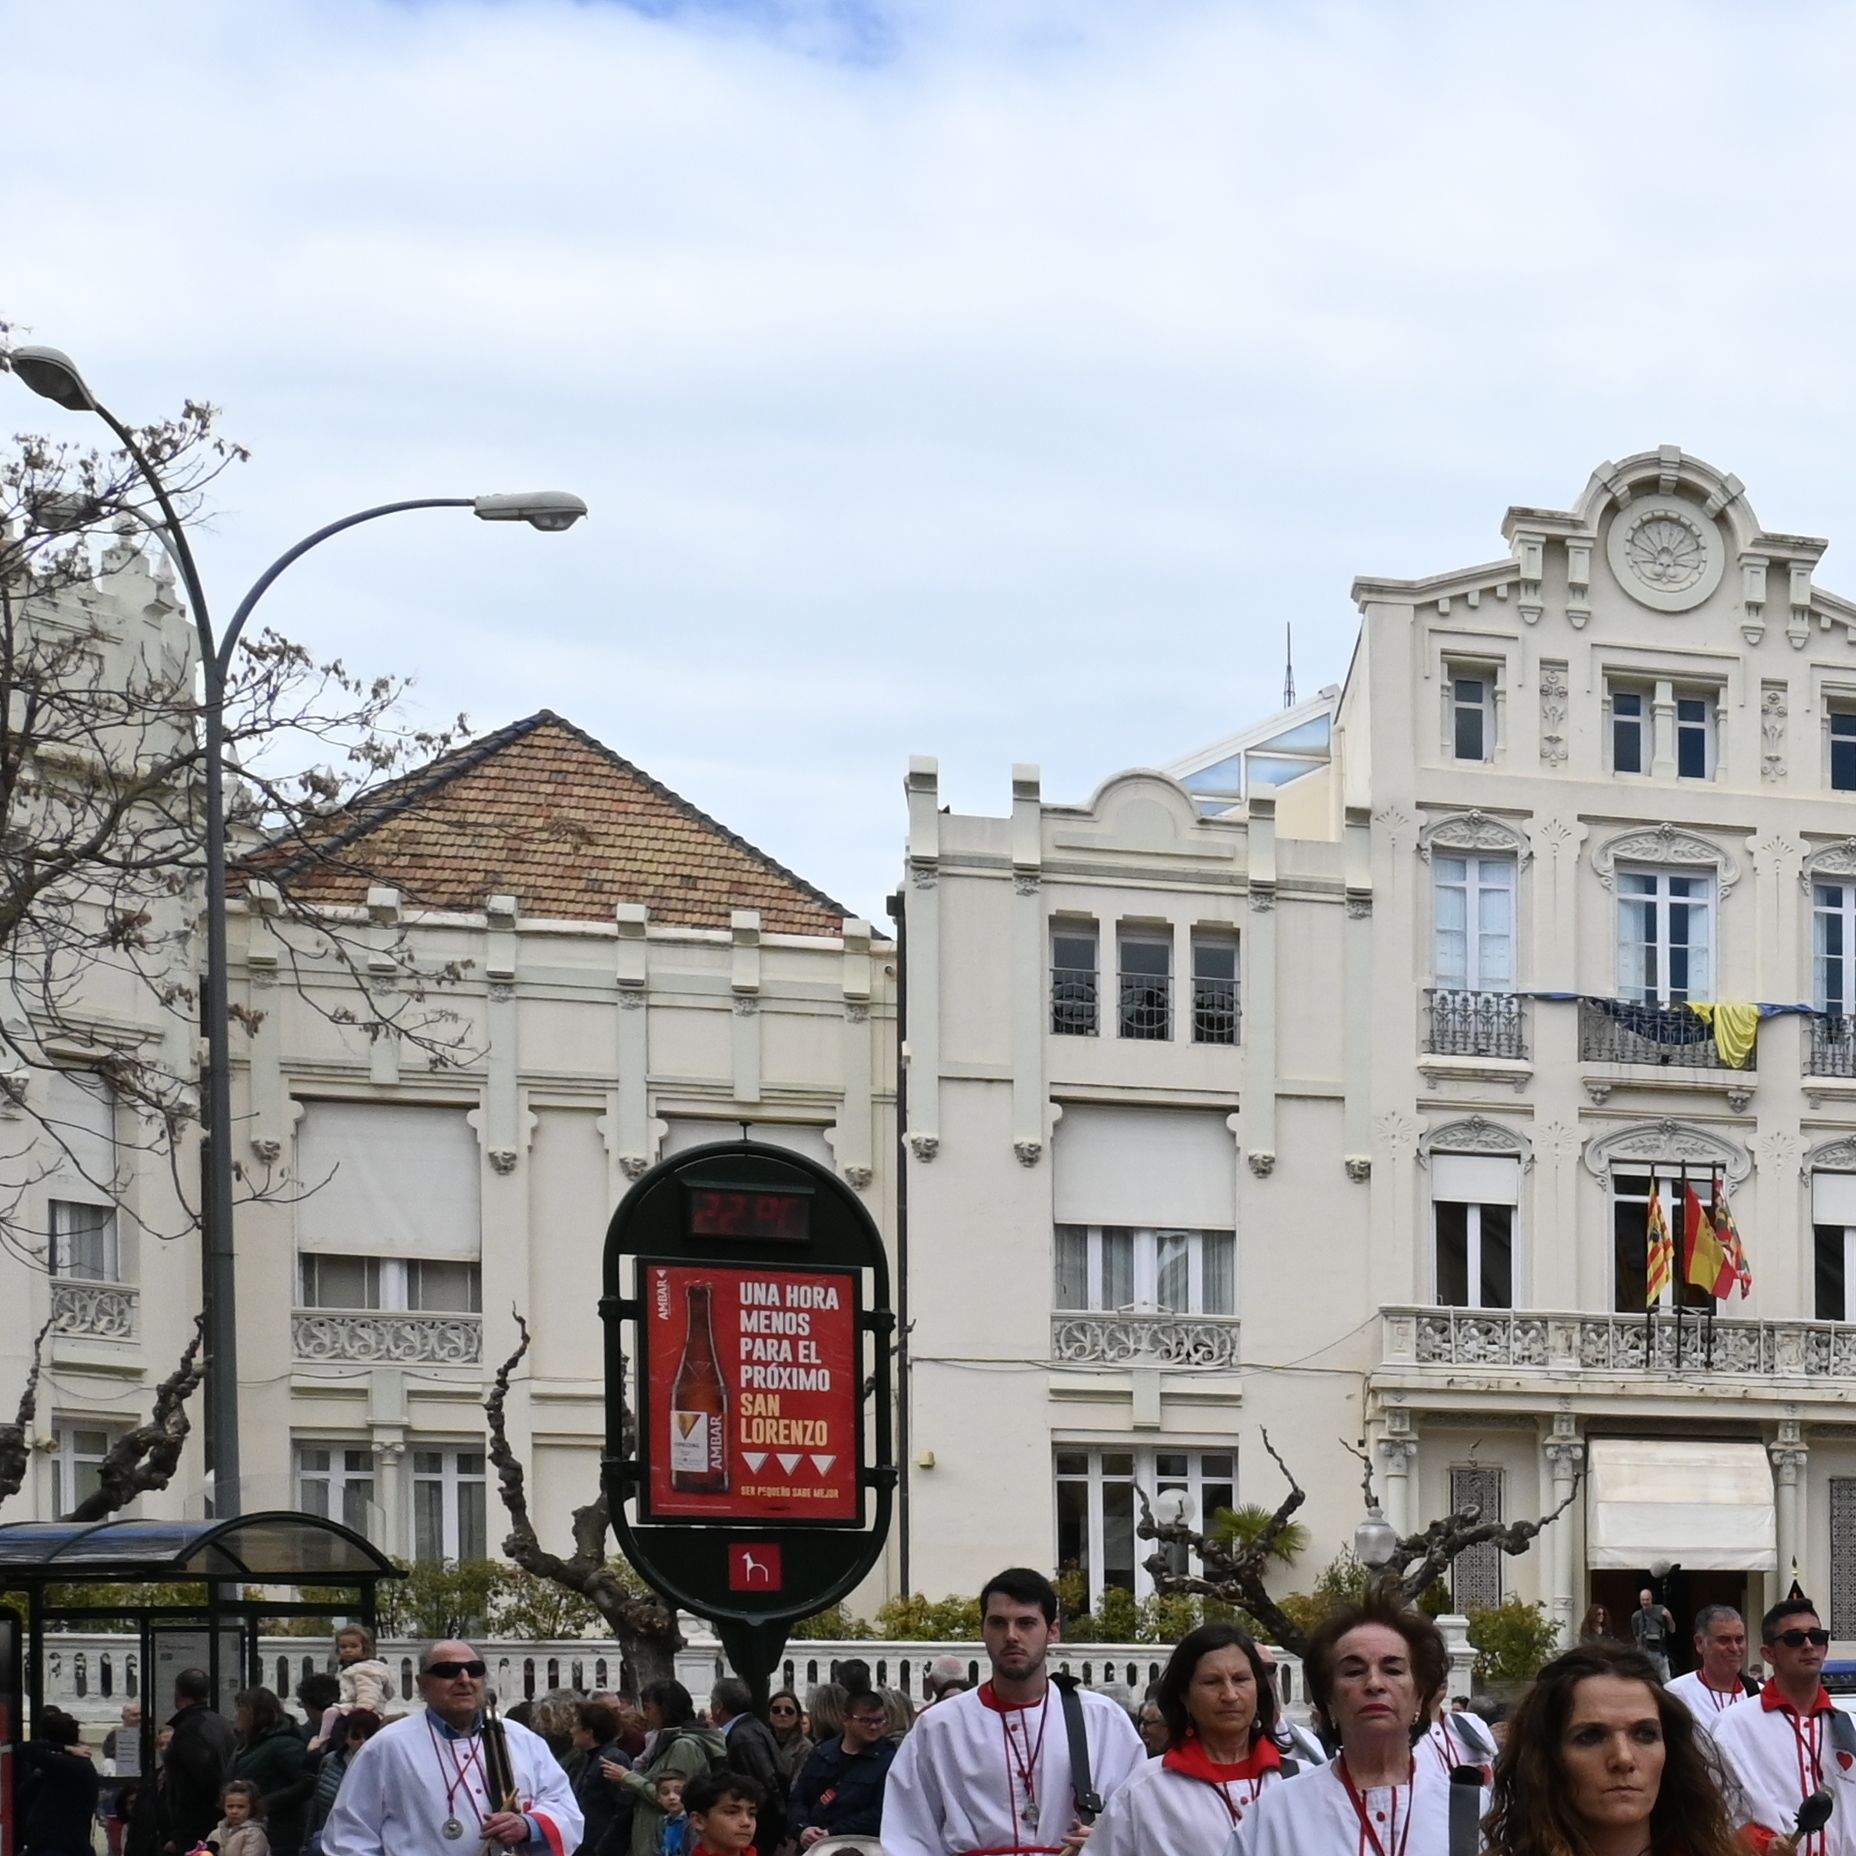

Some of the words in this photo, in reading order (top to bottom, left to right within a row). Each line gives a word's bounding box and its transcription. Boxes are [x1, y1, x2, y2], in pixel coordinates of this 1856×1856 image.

[657, 1279, 669, 1320] AMBAR
[740, 1282, 780, 1306] UNA
[785, 1285, 839, 1310] HORA
[740, 1309, 810, 1336] MENOS
[740, 1337, 793, 1362] PARA
[798, 1340, 822, 1364] EL
[740, 1362, 831, 1392] PRÓXIMO
[740, 1392, 780, 1417] SAN
[709, 1415, 723, 1469] AMBAR
[740, 1417, 828, 1447] LORENZO
[740, 1485, 756, 1496] SER
[813, 1488, 839, 1499] MEJOR
